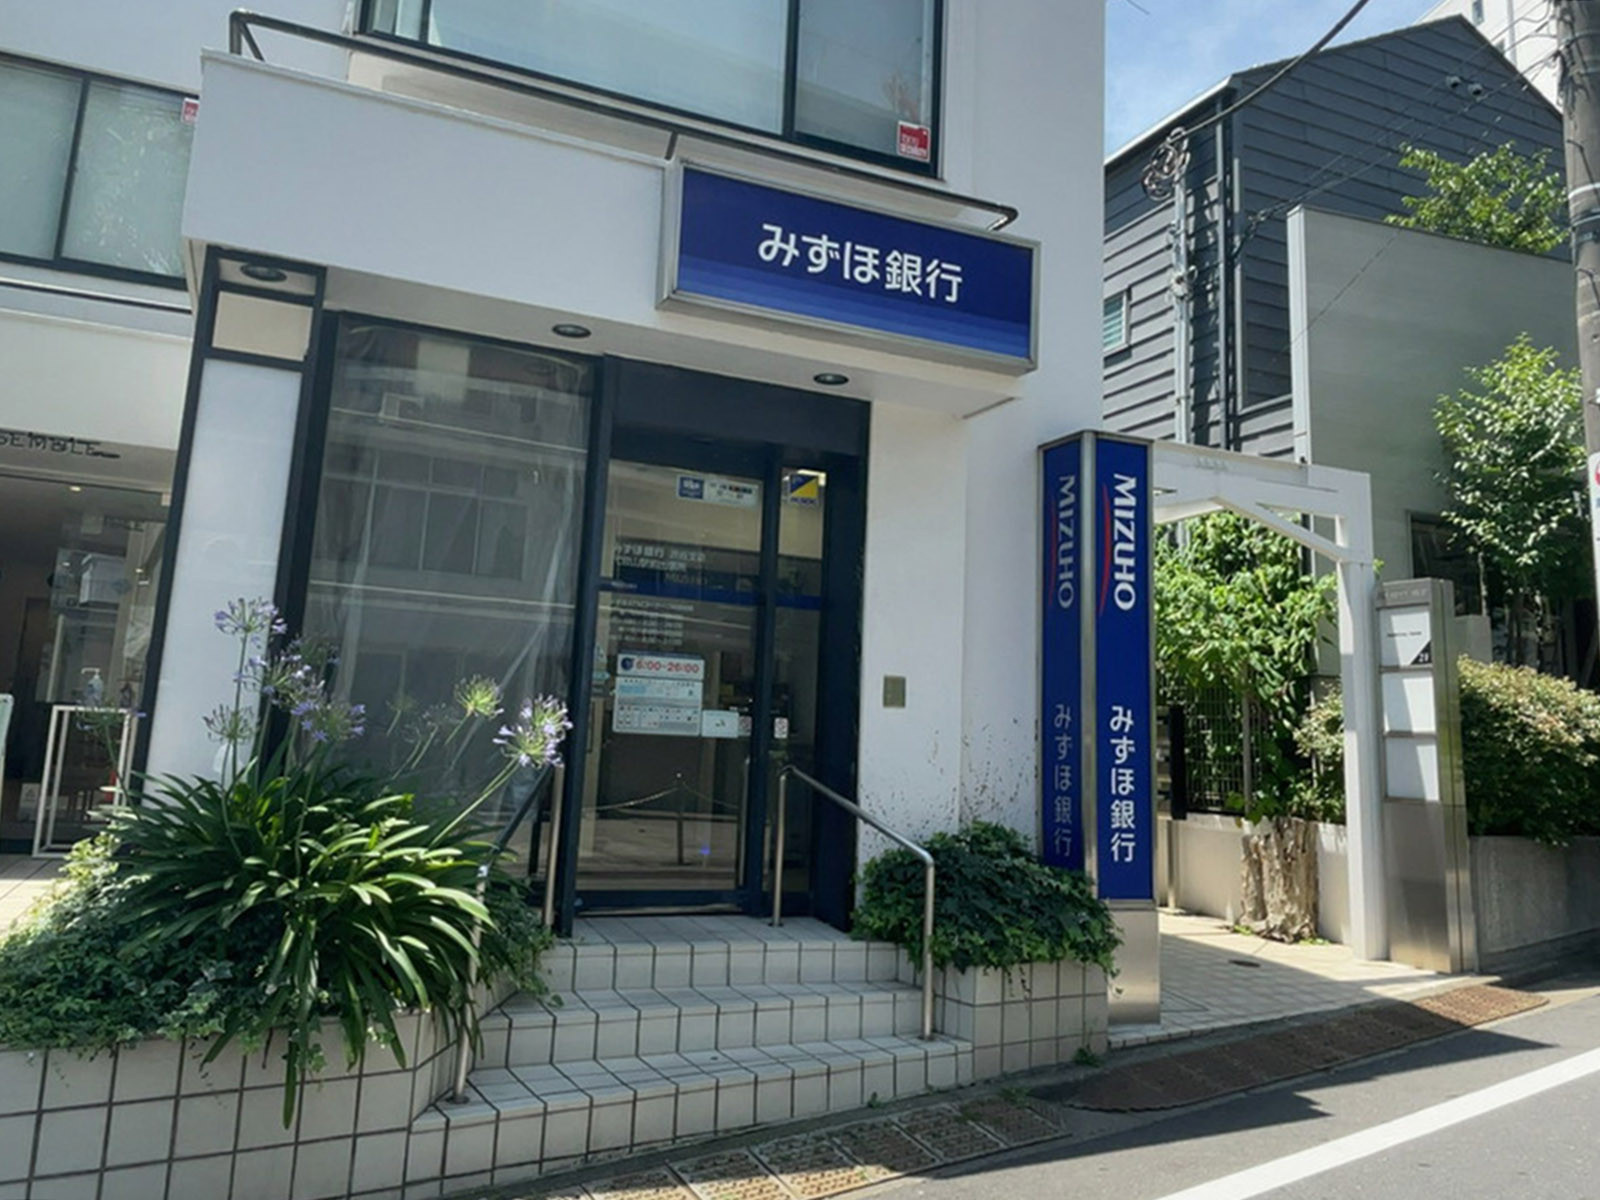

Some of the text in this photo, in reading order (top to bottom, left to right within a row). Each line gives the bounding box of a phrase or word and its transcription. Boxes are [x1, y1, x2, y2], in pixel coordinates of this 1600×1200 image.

[757, 222, 963, 303] みずほ銀行
[1057, 474, 1076, 609] MIZUHO
[1113, 473, 1137, 610] MIZUHO
[1054, 704, 1073, 857] みずほ銀行
[1109, 705, 1135, 863] みずほ銀行
